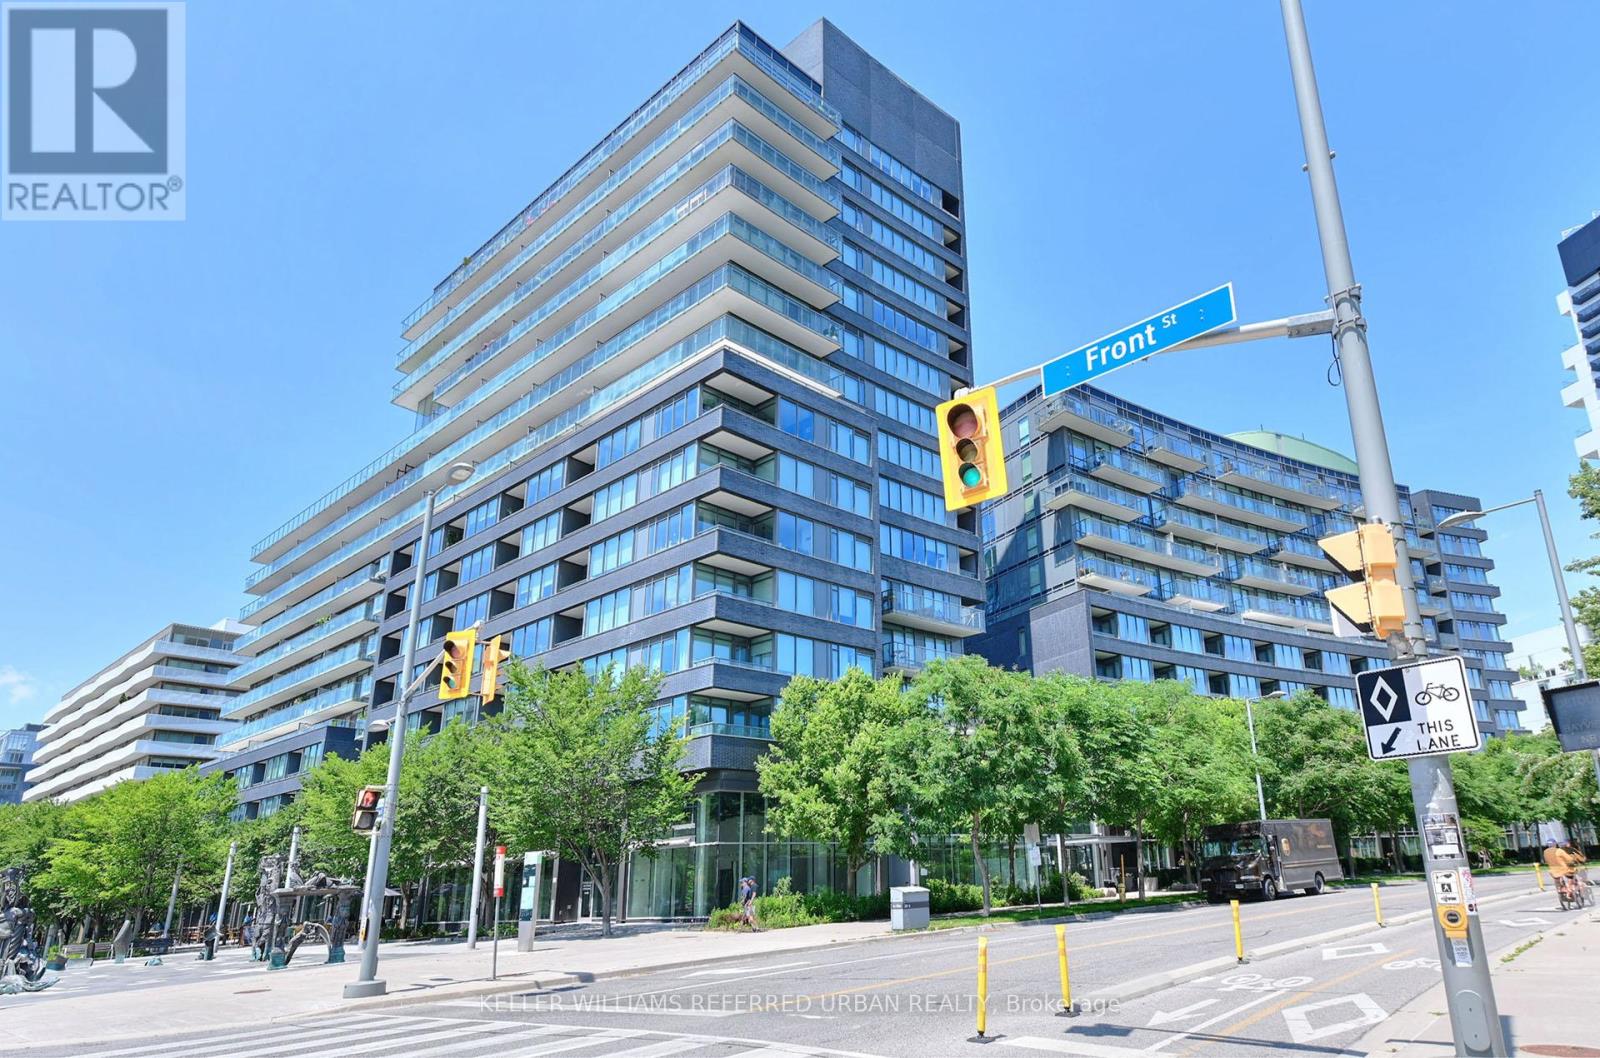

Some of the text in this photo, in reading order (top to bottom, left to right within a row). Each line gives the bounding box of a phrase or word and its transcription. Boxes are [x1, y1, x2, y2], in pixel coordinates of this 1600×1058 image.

[1085, 313, 1178, 371] Front St
[1417, 719, 1454, 735] THIS
[1417, 734, 1461, 751] LANE
